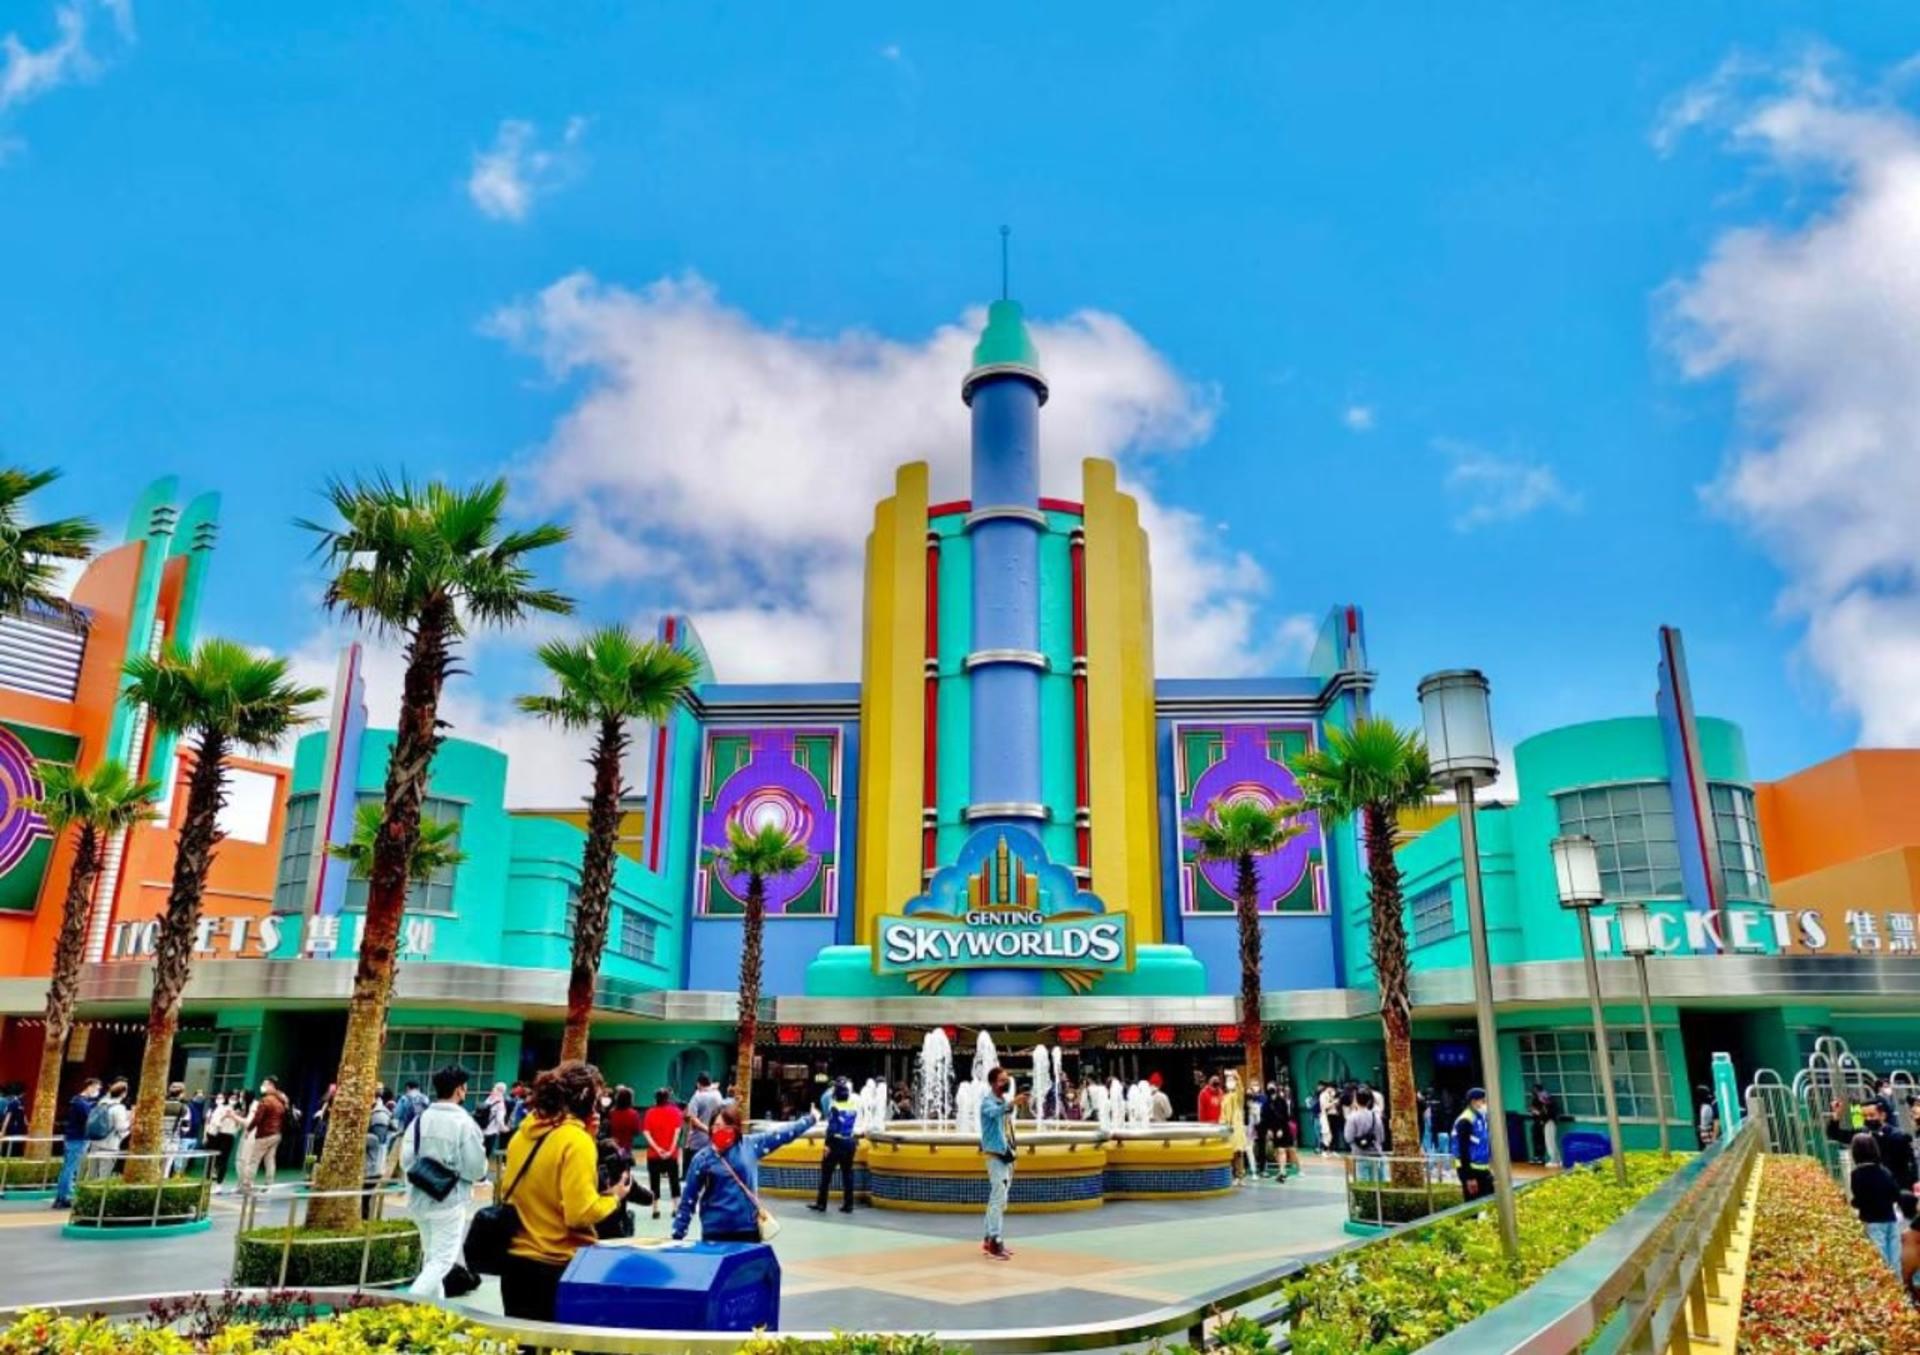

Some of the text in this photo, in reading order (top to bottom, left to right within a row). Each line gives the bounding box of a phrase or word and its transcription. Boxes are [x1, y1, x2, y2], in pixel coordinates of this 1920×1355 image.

[111, 914, 285, 956] TICETS
[965, 910, 1043, 926] GENTING
[1589, 908, 1827, 950] TCKETS
[886, 924, 1121, 963] SKYWORLDS
